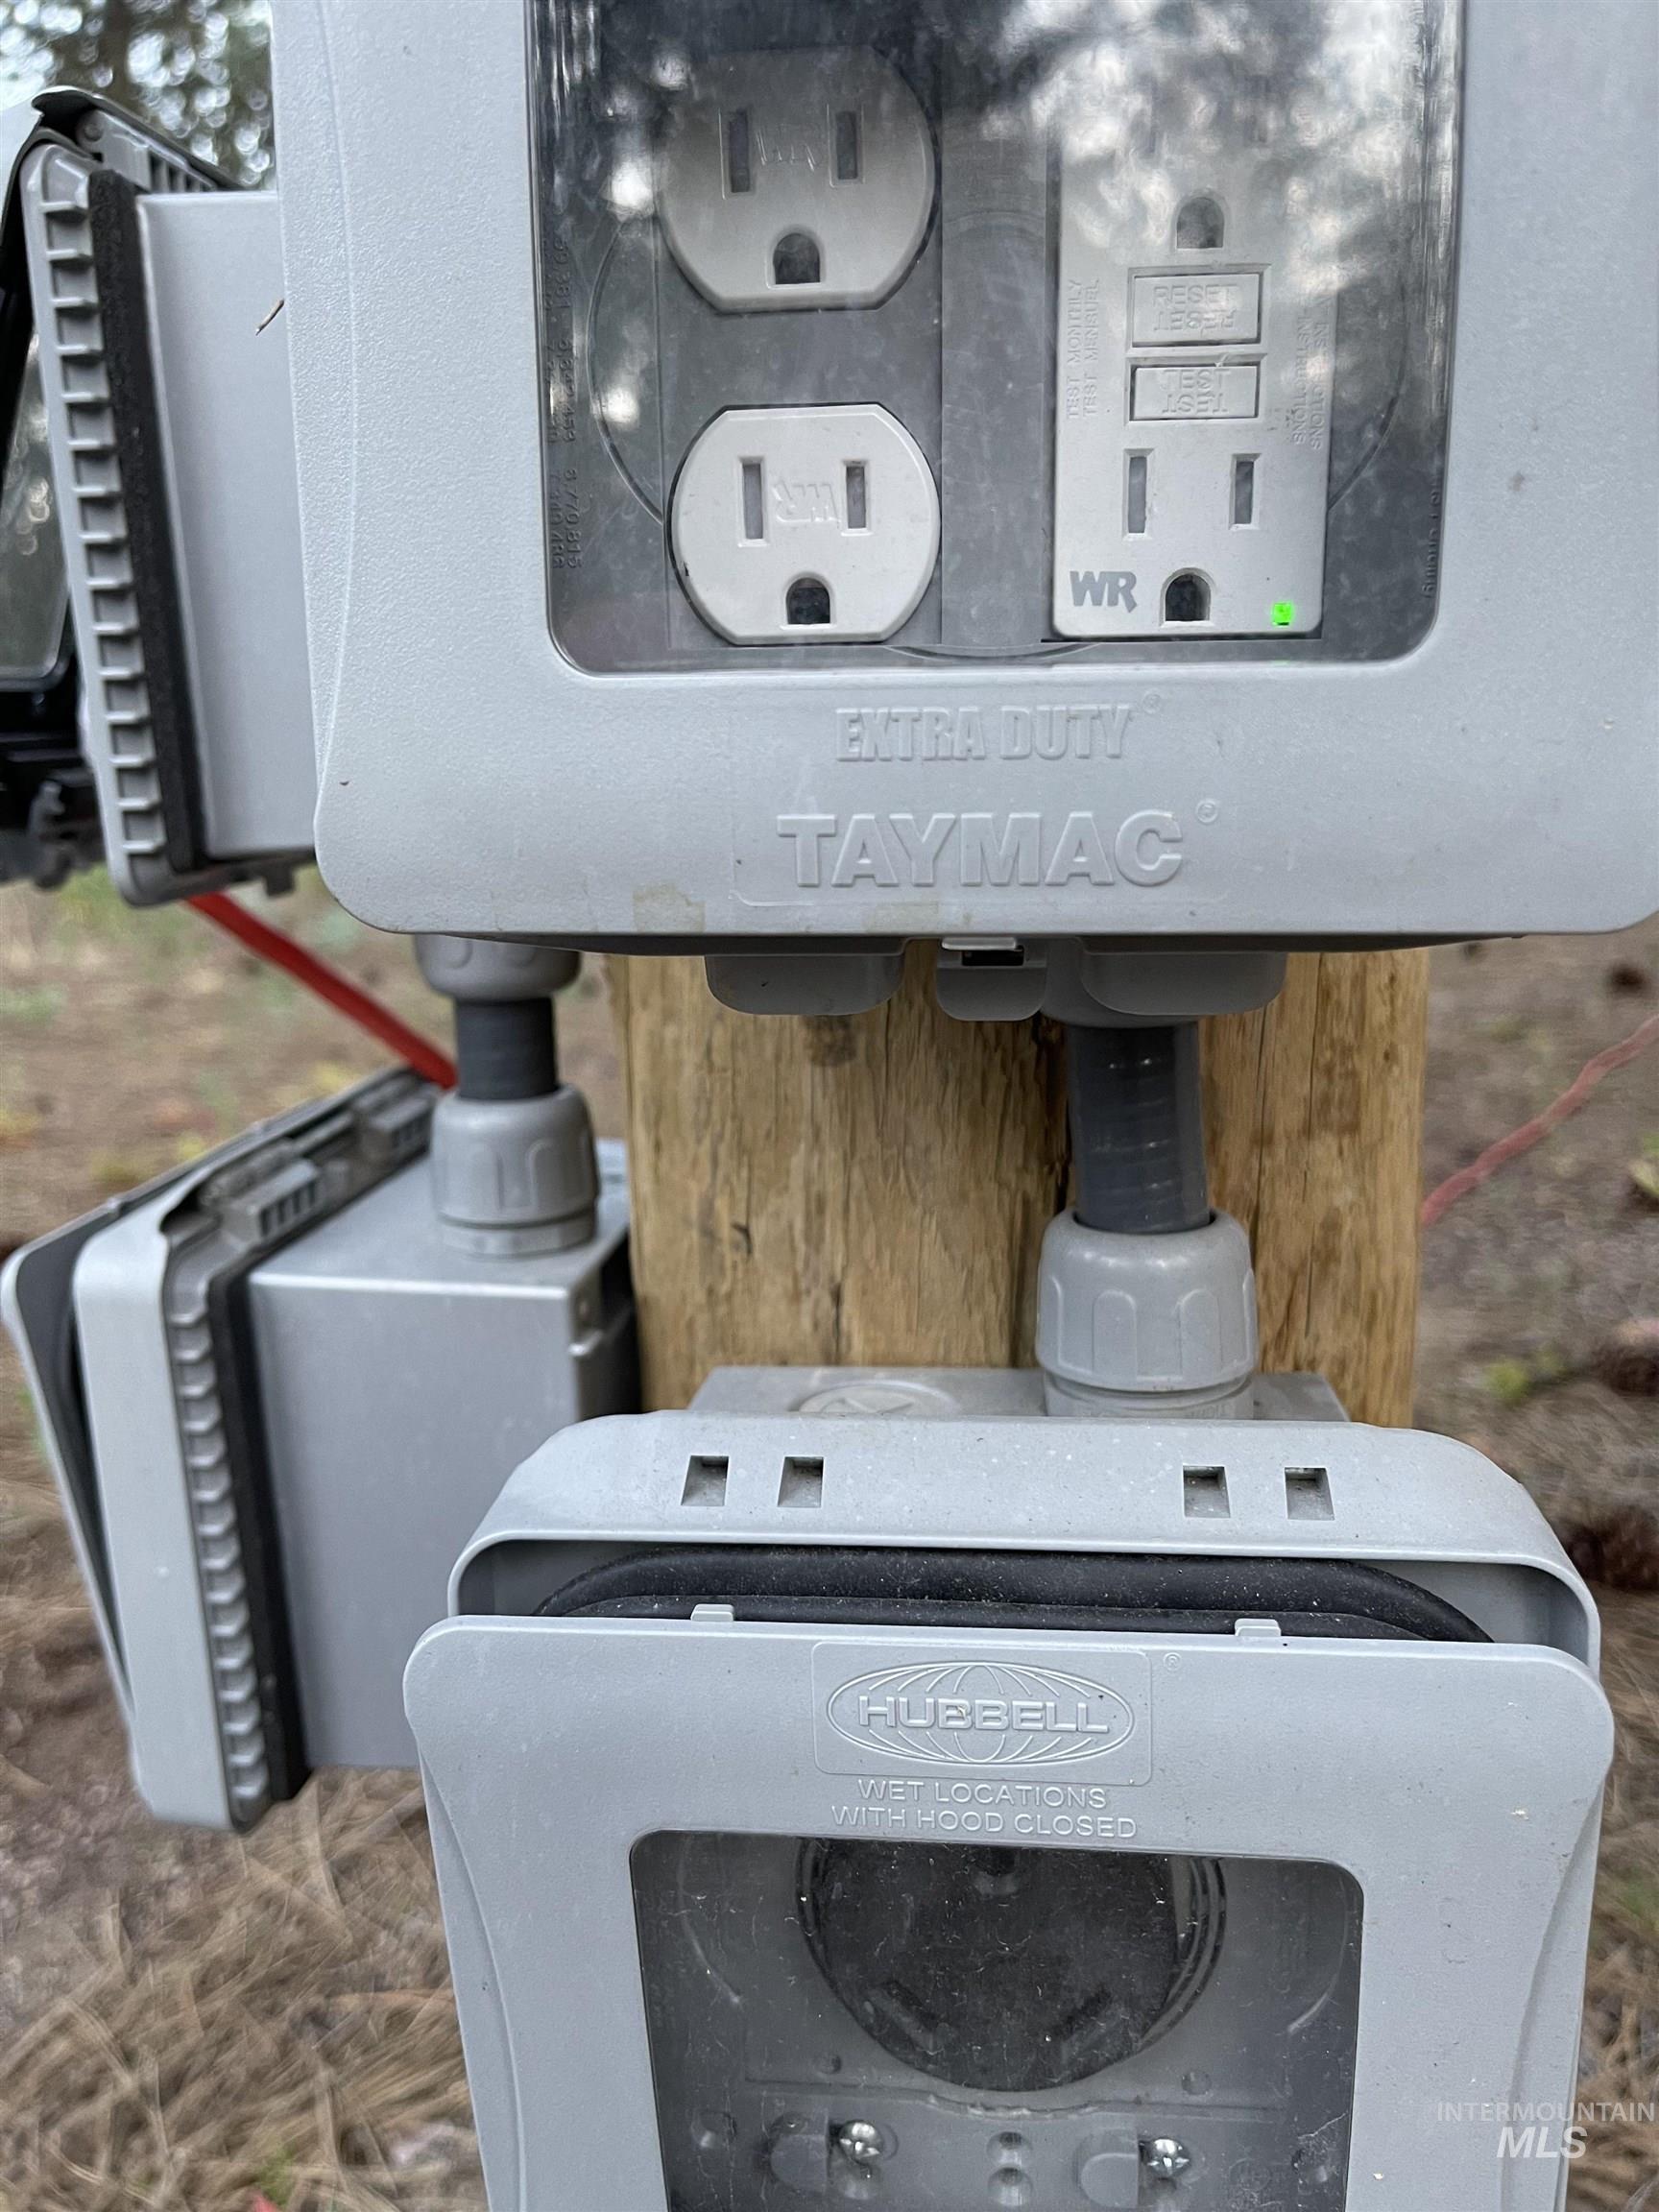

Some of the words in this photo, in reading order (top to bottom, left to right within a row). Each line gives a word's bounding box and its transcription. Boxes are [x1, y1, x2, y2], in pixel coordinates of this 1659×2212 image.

[1153, 283, 1238, 306] RESET
[1067, 278, 1082, 365] MONTHLY
[1084, 278, 1099, 363] MENSUEL
[1153, 308, 1236, 332] RESET
[1067, 375, 1080, 420] TEST
[1083, 373, 1097, 418] TEST
[1160, 369, 1231, 390] TEST
[1160, 393, 1228, 415] TEST
[1070, 569, 1138, 613] WR
[835, 706, 986, 761] EXTRA
[999, 704, 1132, 760] DUTY
[777, 808, 1183, 887] TAYMAC
[857, 1695, 1109, 1734] HUBBELL
[857, 1779, 925, 1802] WET
[934, 1782, 1107, 1810] LOCATIONS
[830, 1805, 906, 1829] WITH
[916, 1809, 1004, 1833] HOOD
[1014, 1813, 1138, 1839] CLOSED
